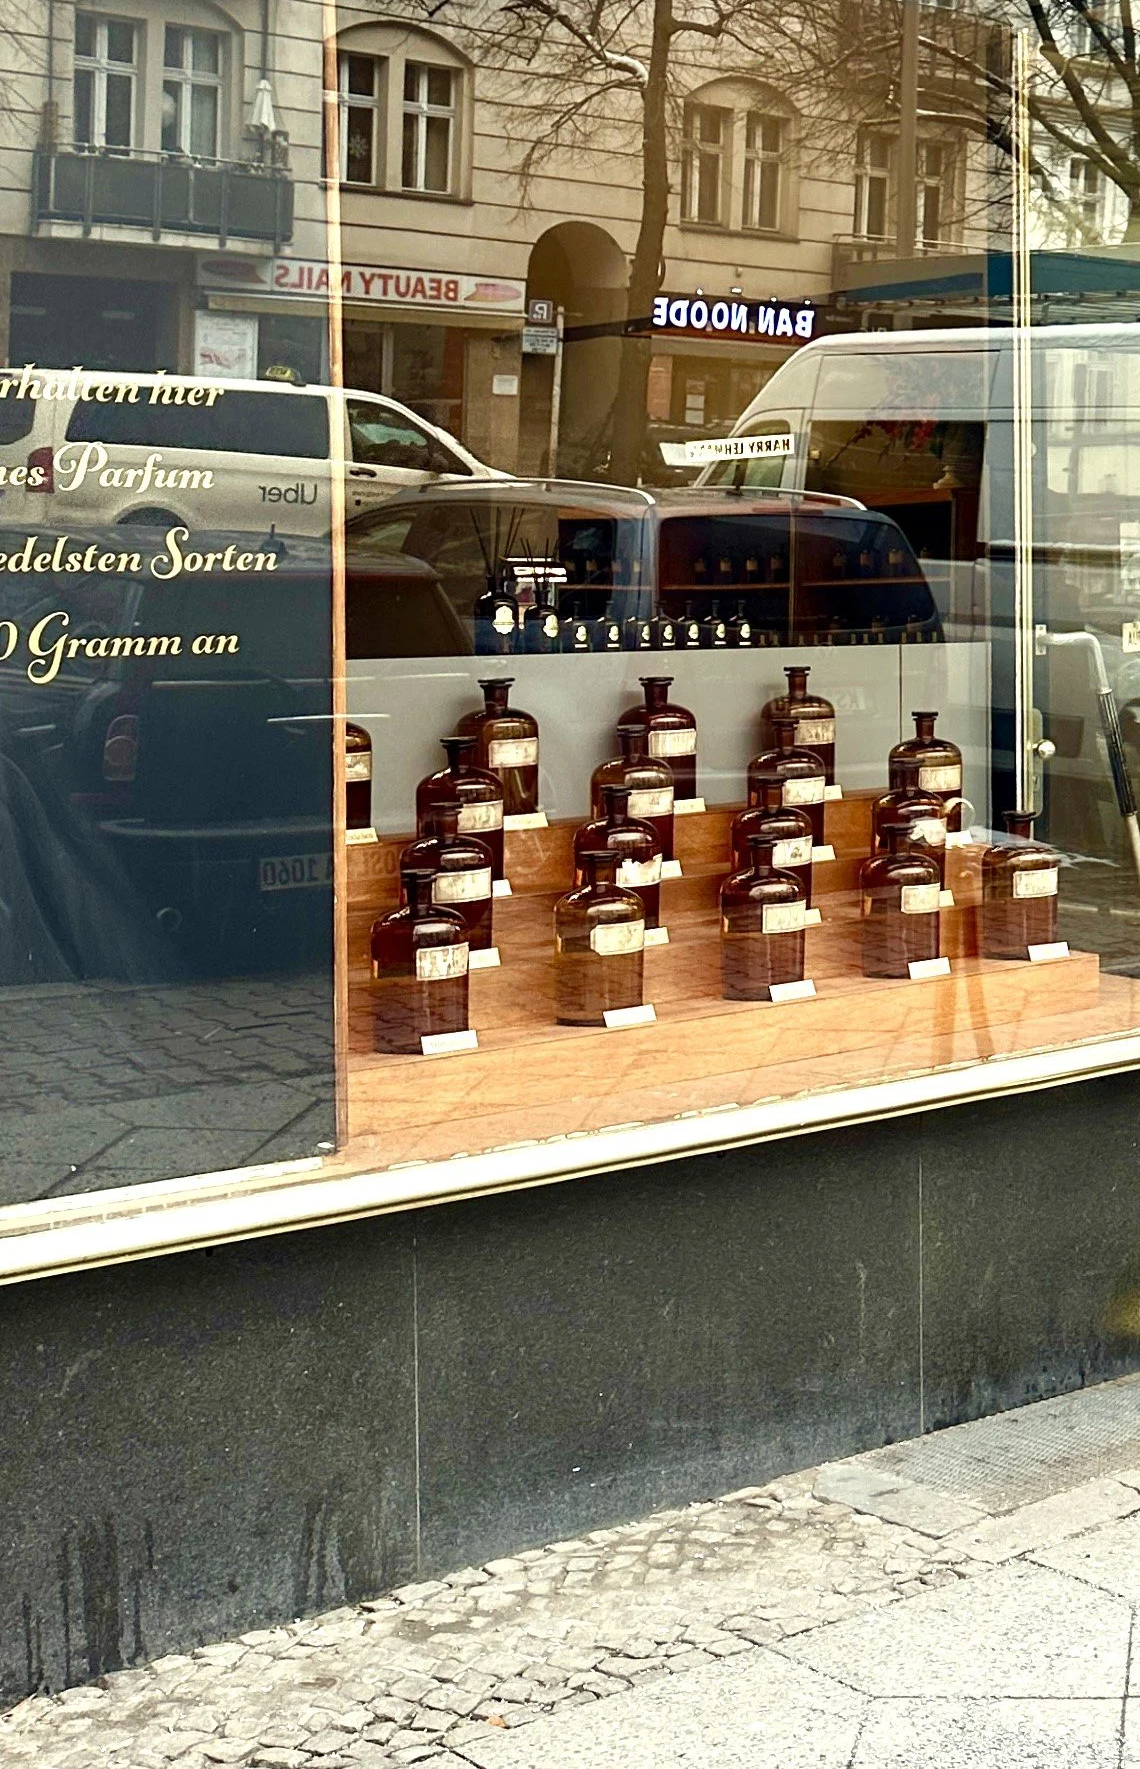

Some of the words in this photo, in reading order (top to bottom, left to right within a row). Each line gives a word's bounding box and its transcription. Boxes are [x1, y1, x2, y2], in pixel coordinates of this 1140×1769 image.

[53, 441, 215, 494] Parfum
[150, 526, 279, 580] Sorten
[27, 611, 183, 684] Gramm
[191, 634, 240, 655] an
